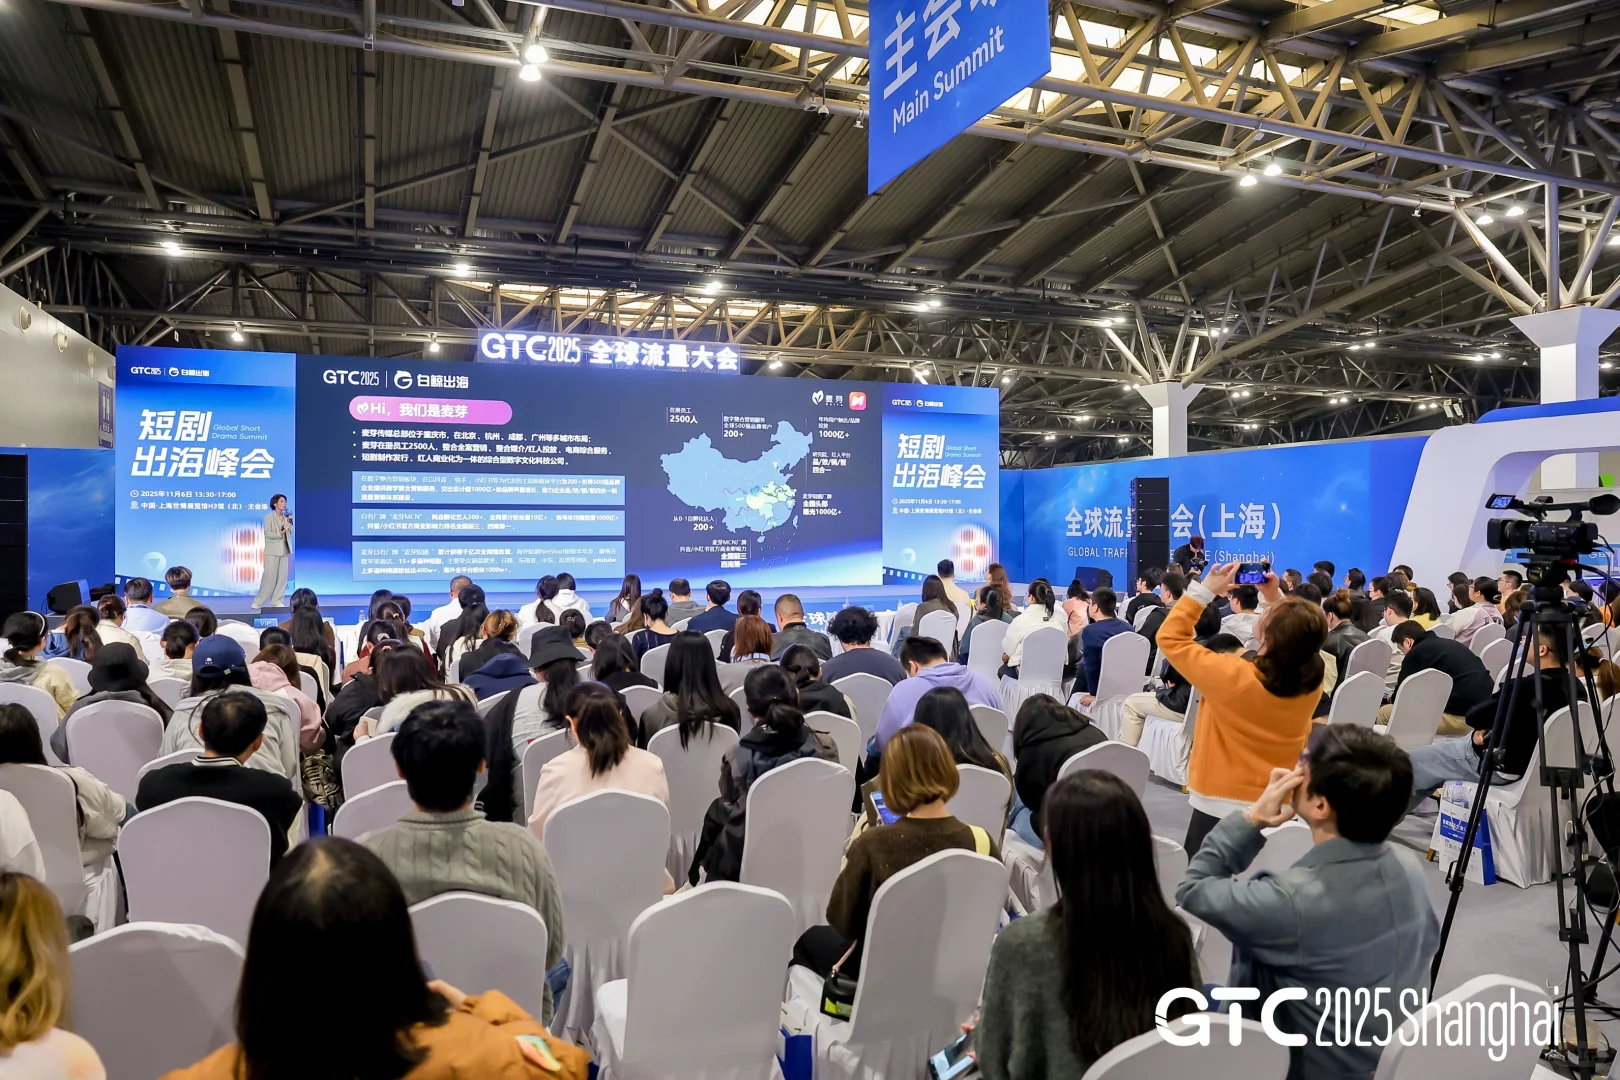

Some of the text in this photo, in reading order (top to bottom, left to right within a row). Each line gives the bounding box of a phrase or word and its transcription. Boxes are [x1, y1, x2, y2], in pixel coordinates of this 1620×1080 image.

[884, 0, 997, 100] 主会
[893, 25, 1005, 134] Main Summit
[589, 339, 739, 370] 全球流量大会
[417, 374, 469, 388] 白鲸出海
[138, 409, 213, 441] 短剧
[670, 415, 698, 424] 2500人
[897, 433, 946, 459] 短剧
[130, 446, 275, 479] 出海峰会
[892, 462, 987, 489] 出海峰会
[693, 523, 714, 531] 200+
[1064, 503, 1281, 540] 全球流会(上海)
[1068, 547, 1101, 558] GLOBAL
[1103, 548, 1128, 559] TRAF
